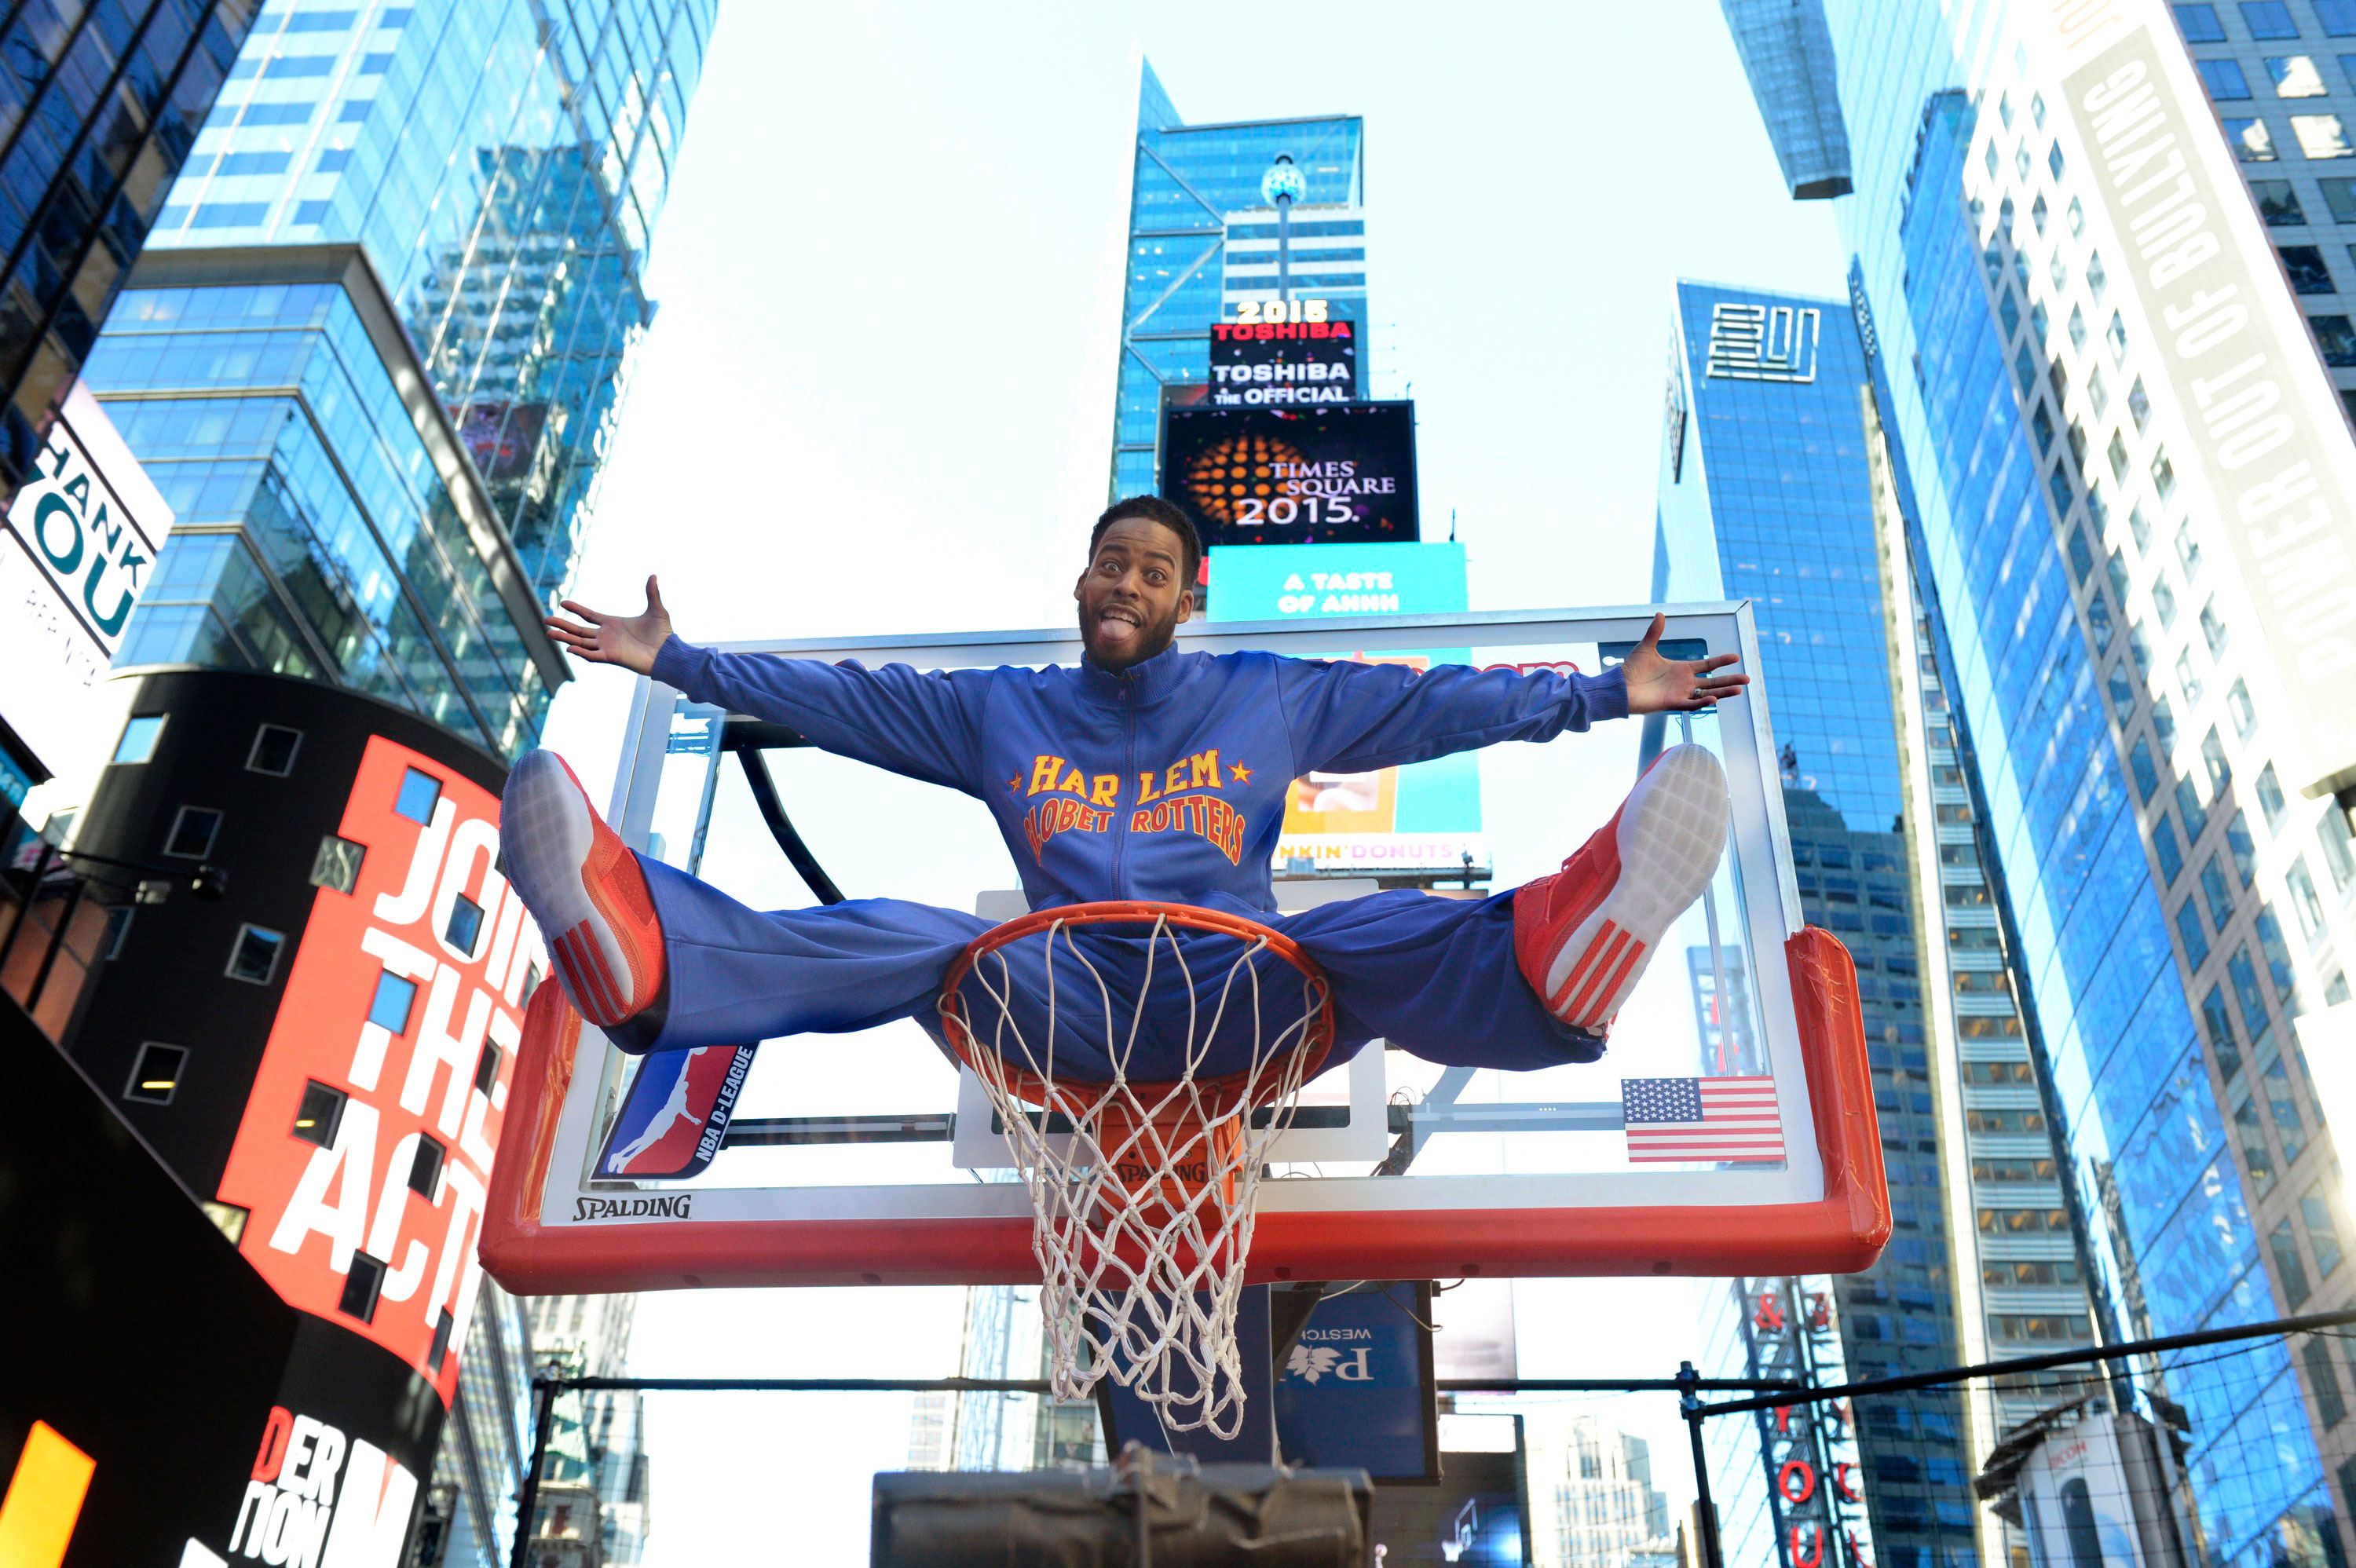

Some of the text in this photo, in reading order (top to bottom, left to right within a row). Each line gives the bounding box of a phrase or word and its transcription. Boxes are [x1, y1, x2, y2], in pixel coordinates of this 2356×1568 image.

[1237, 299, 1328, 324] 2015
[1213, 322, 1352, 341] TOSHIBA
[1213, 362, 1351, 383] TOSHIBA
[2082, 60, 2356, 685] POWER OUT OF BULLYING
[1215, 386, 1350, 405] THE OFFICIAL
[1269, 460, 1355, 479] TIMES
[1286, 477, 1396, 498] SQUARE
[46, 440, 148, 590] HANK
[33, 488, 134, 638] OU
[1283, 572, 1393, 592] A TASTE
[1277, 594, 1315, 613] OF
[1271, 844, 1453, 859] NKIN' DONUTS
[695, 1045, 754, 1163] NBA D-LEAGUE
[1116, 1161, 1206, 1183] SPAING
[572, 1193, 692, 1222] SPALDING
